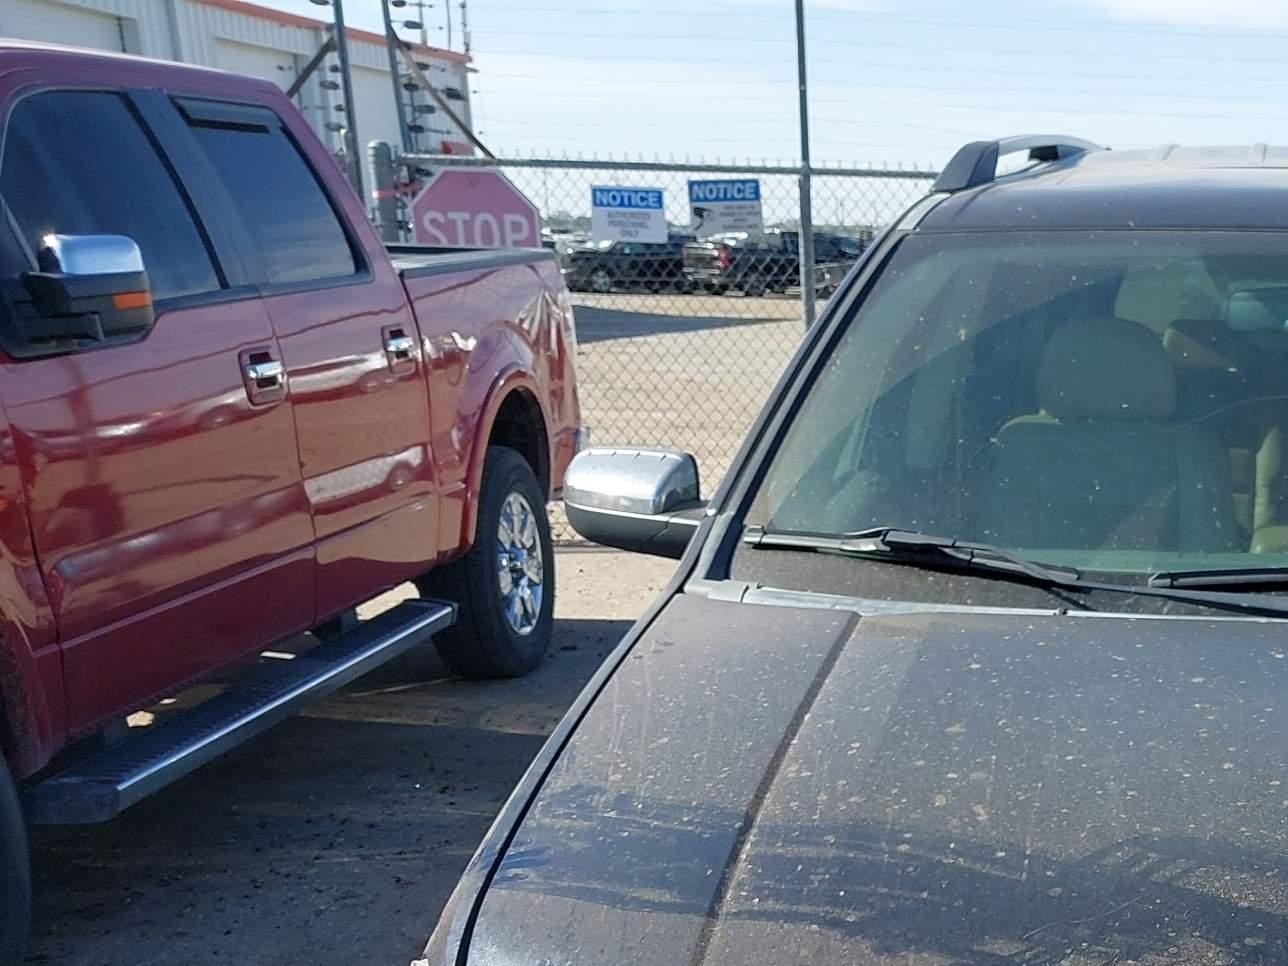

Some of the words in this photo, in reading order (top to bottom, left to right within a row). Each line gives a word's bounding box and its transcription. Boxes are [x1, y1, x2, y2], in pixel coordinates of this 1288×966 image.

[594, 190, 660, 208] NOTICE
[692, 182, 756, 200] NOTICE
[422, 210, 530, 248] STOP
